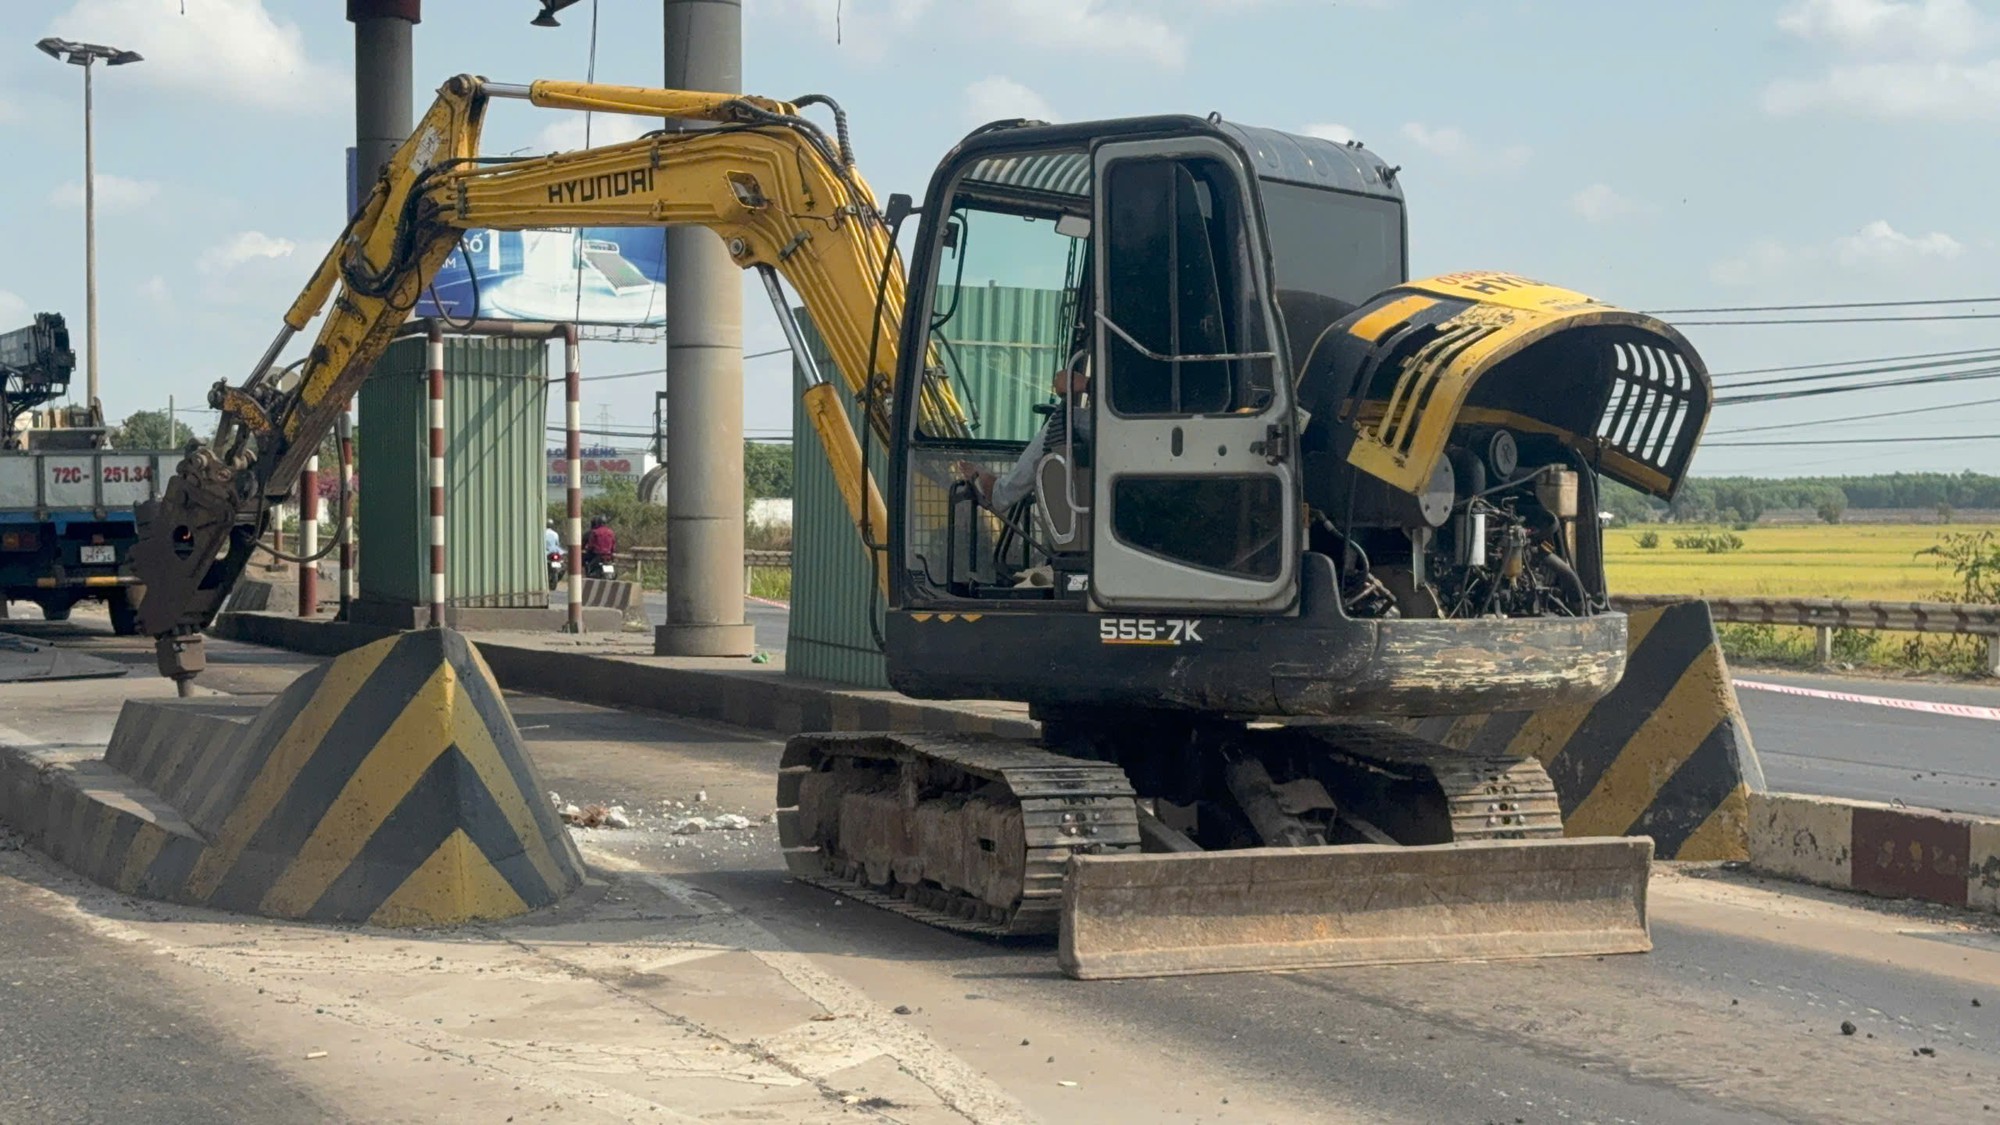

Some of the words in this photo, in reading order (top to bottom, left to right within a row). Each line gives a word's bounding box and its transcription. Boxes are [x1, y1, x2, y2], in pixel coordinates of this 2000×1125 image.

[548, 167, 654, 203] HYUNDAI
[103, 466, 153, 483] 251.34
[1100, 619, 1203, 641] 555-7K
